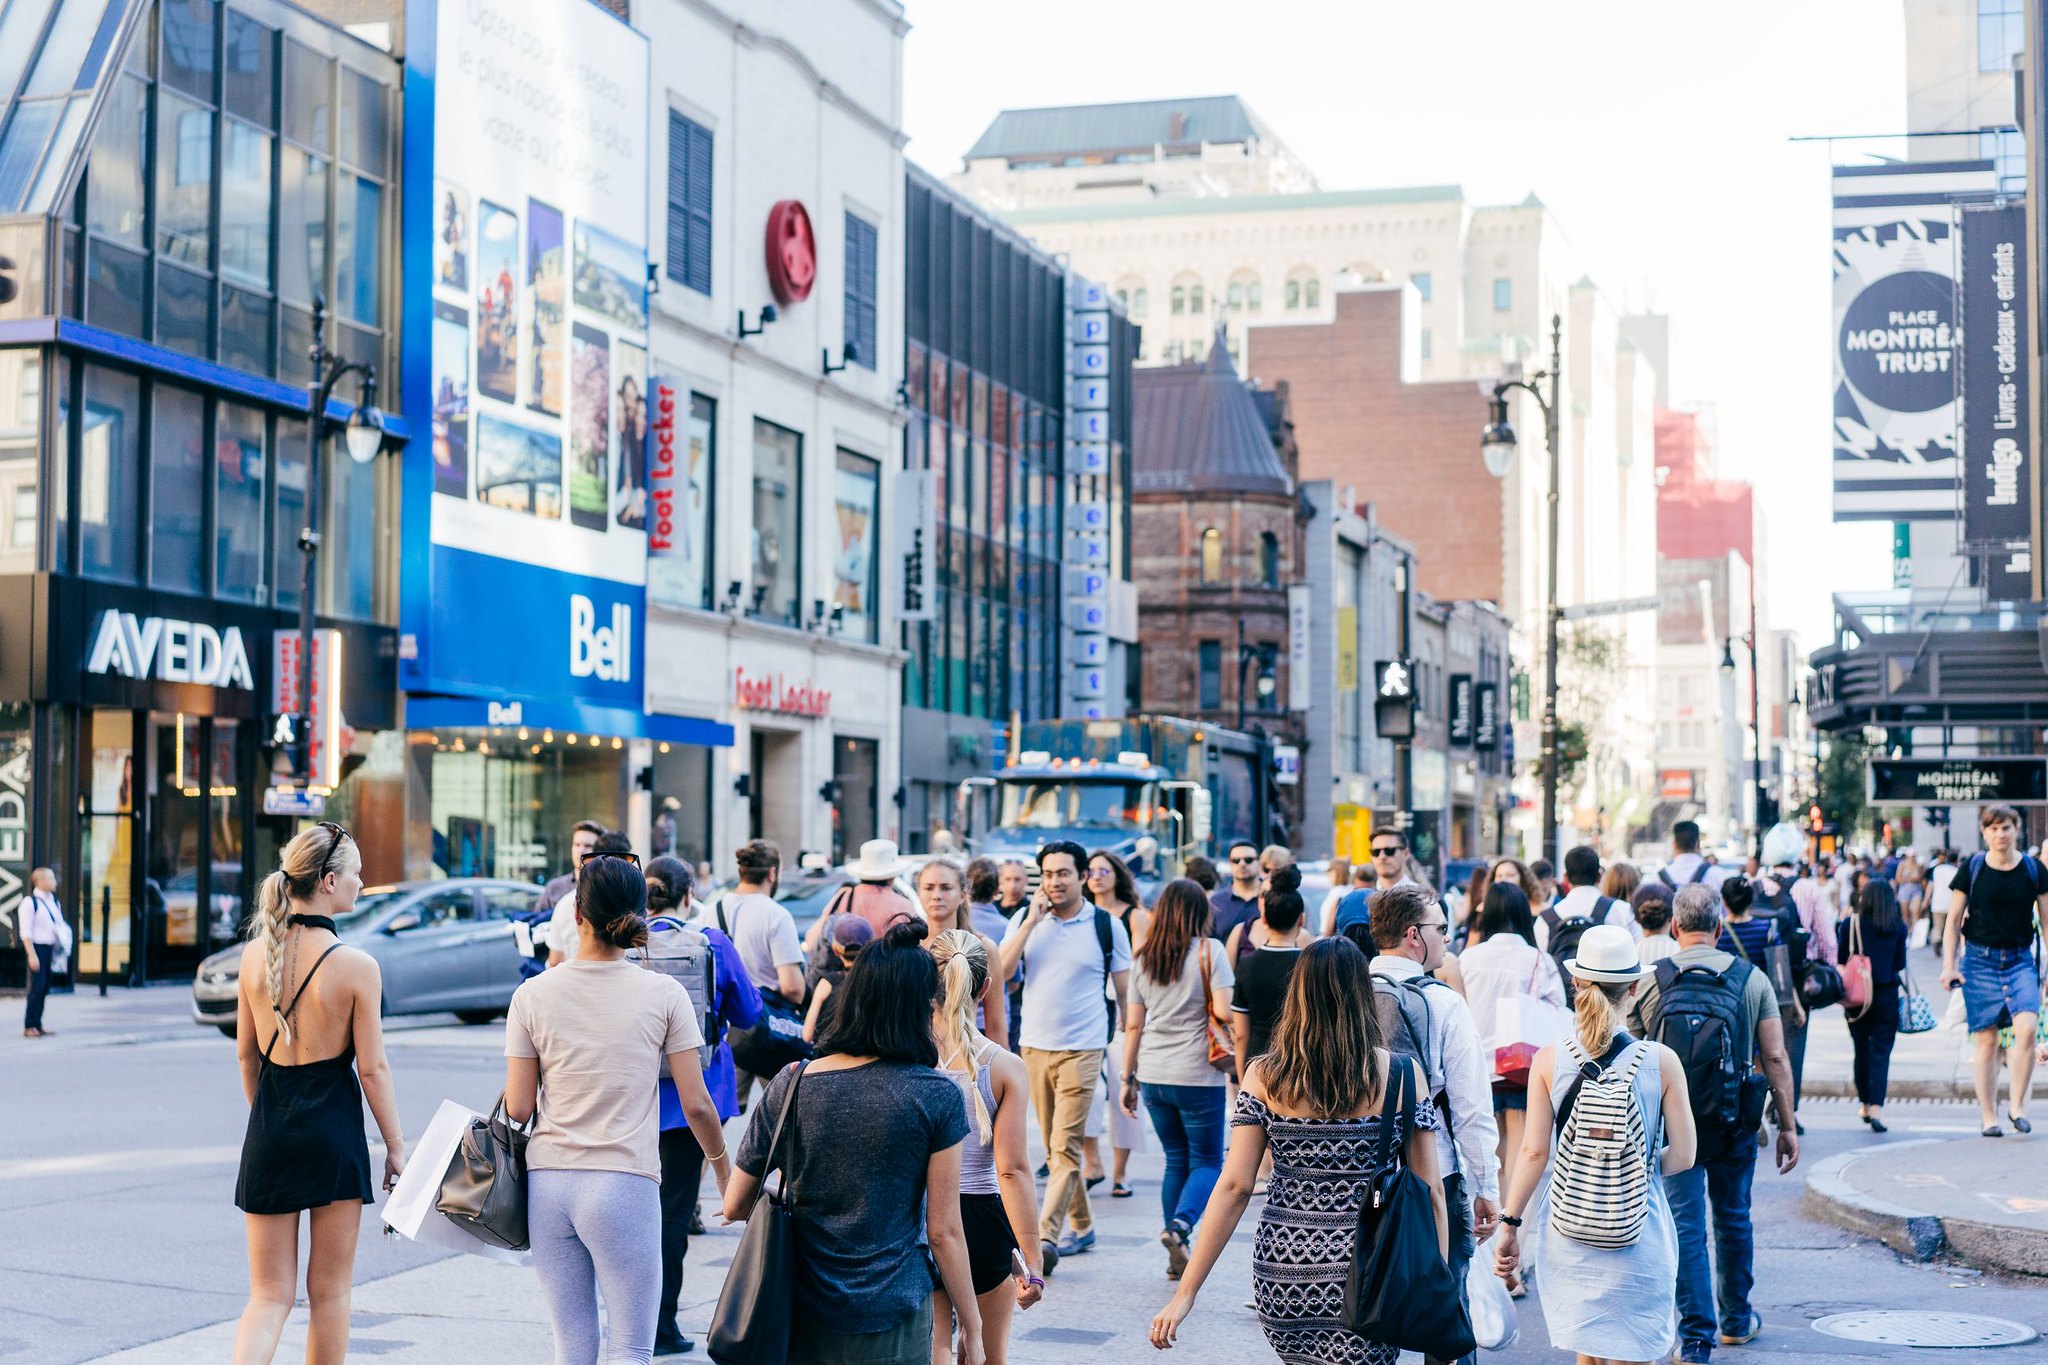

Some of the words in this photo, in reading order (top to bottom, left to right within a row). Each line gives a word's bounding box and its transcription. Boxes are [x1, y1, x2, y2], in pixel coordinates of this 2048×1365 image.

[1889, 310, 1938, 325] PLACE
[1875, 351, 1951, 374] TRUST
[650, 384, 675, 480] Locker
[1986, 437, 2023, 505] Indigo
[650, 488, 673, 551] Foot
[88, 608, 254, 691] AVEDA
[570, 593, 632, 683] Bell
[488, 701, 522, 725] Bell
[736, 665, 772, 711] Foot
[779, 672, 833, 718] Locker
[1917, 769, 2000, 787] MONTRÉAL
[1935, 786, 1982, 800] TRUST
